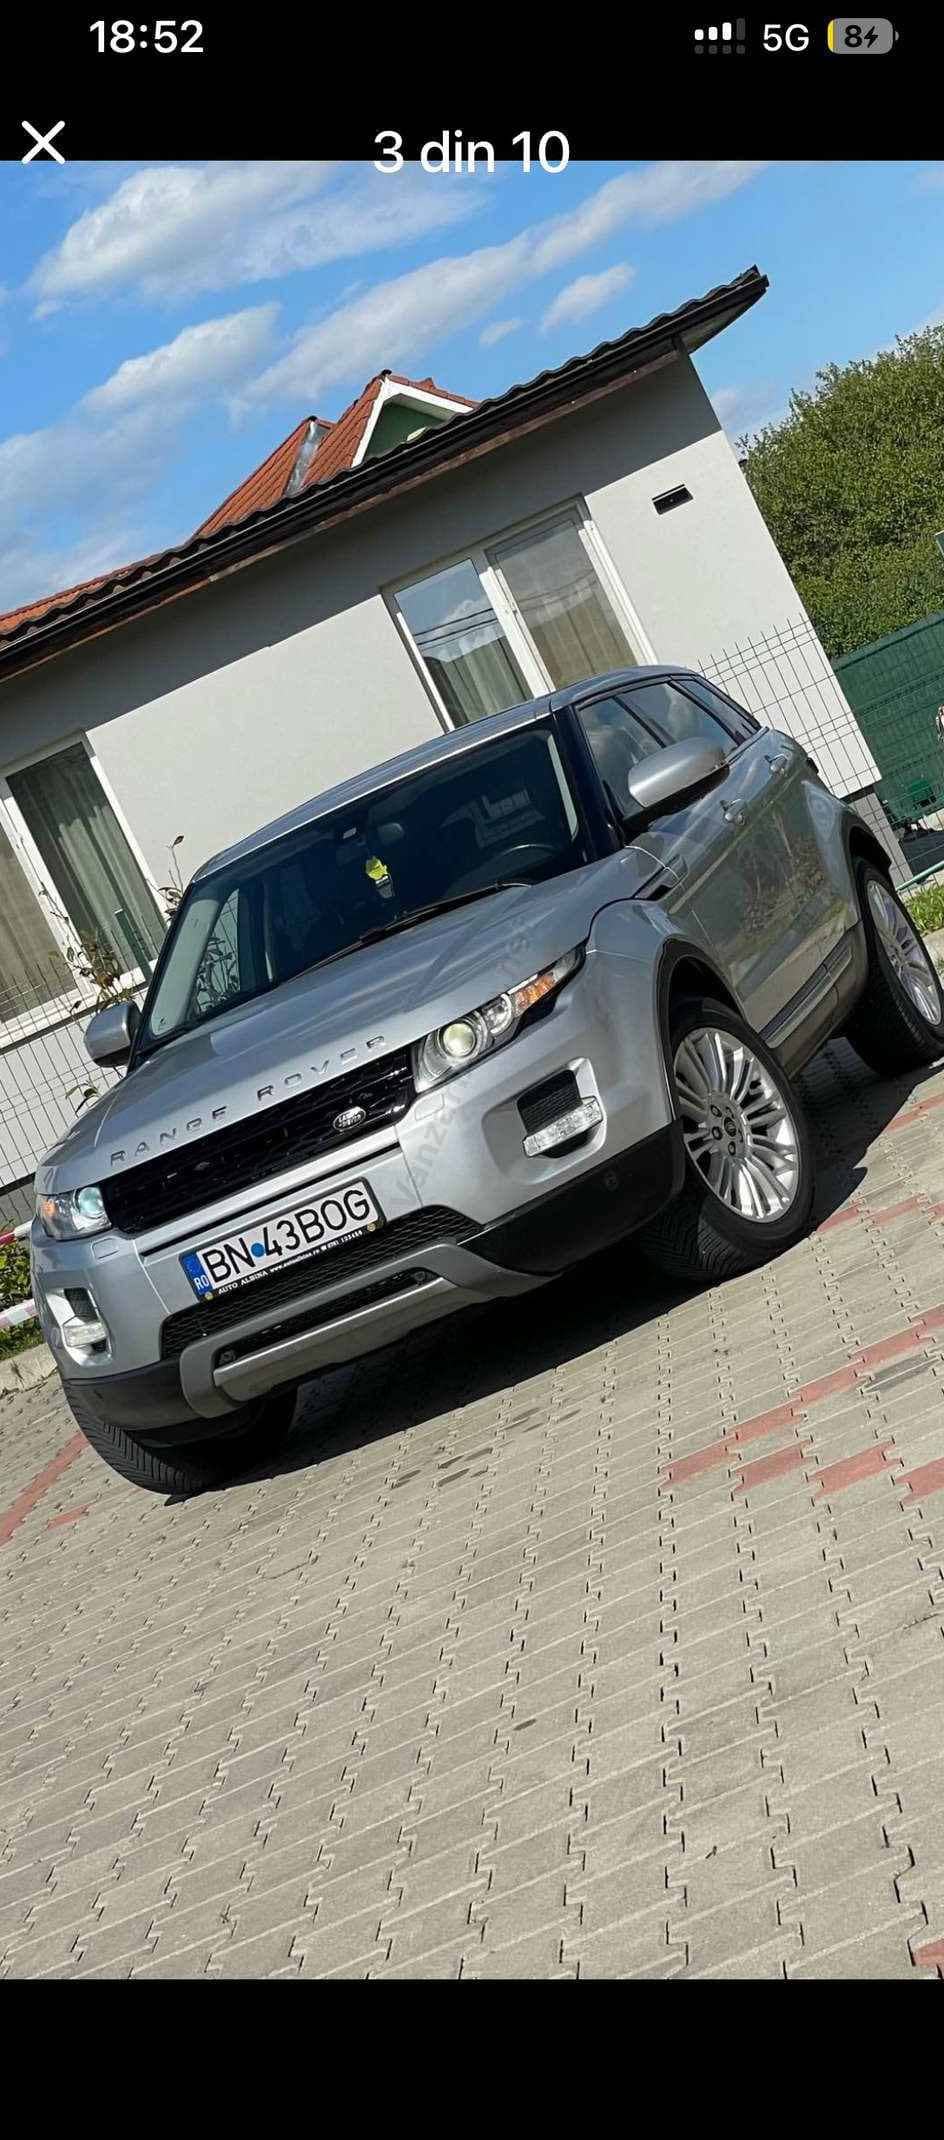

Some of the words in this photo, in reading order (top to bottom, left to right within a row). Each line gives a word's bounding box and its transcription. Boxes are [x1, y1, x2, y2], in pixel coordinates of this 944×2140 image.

[109, 1105, 228, 1168] RANGE
[193, 1274, 210, 1290] RO
[218, 1282, 238, 1295] AUTO
